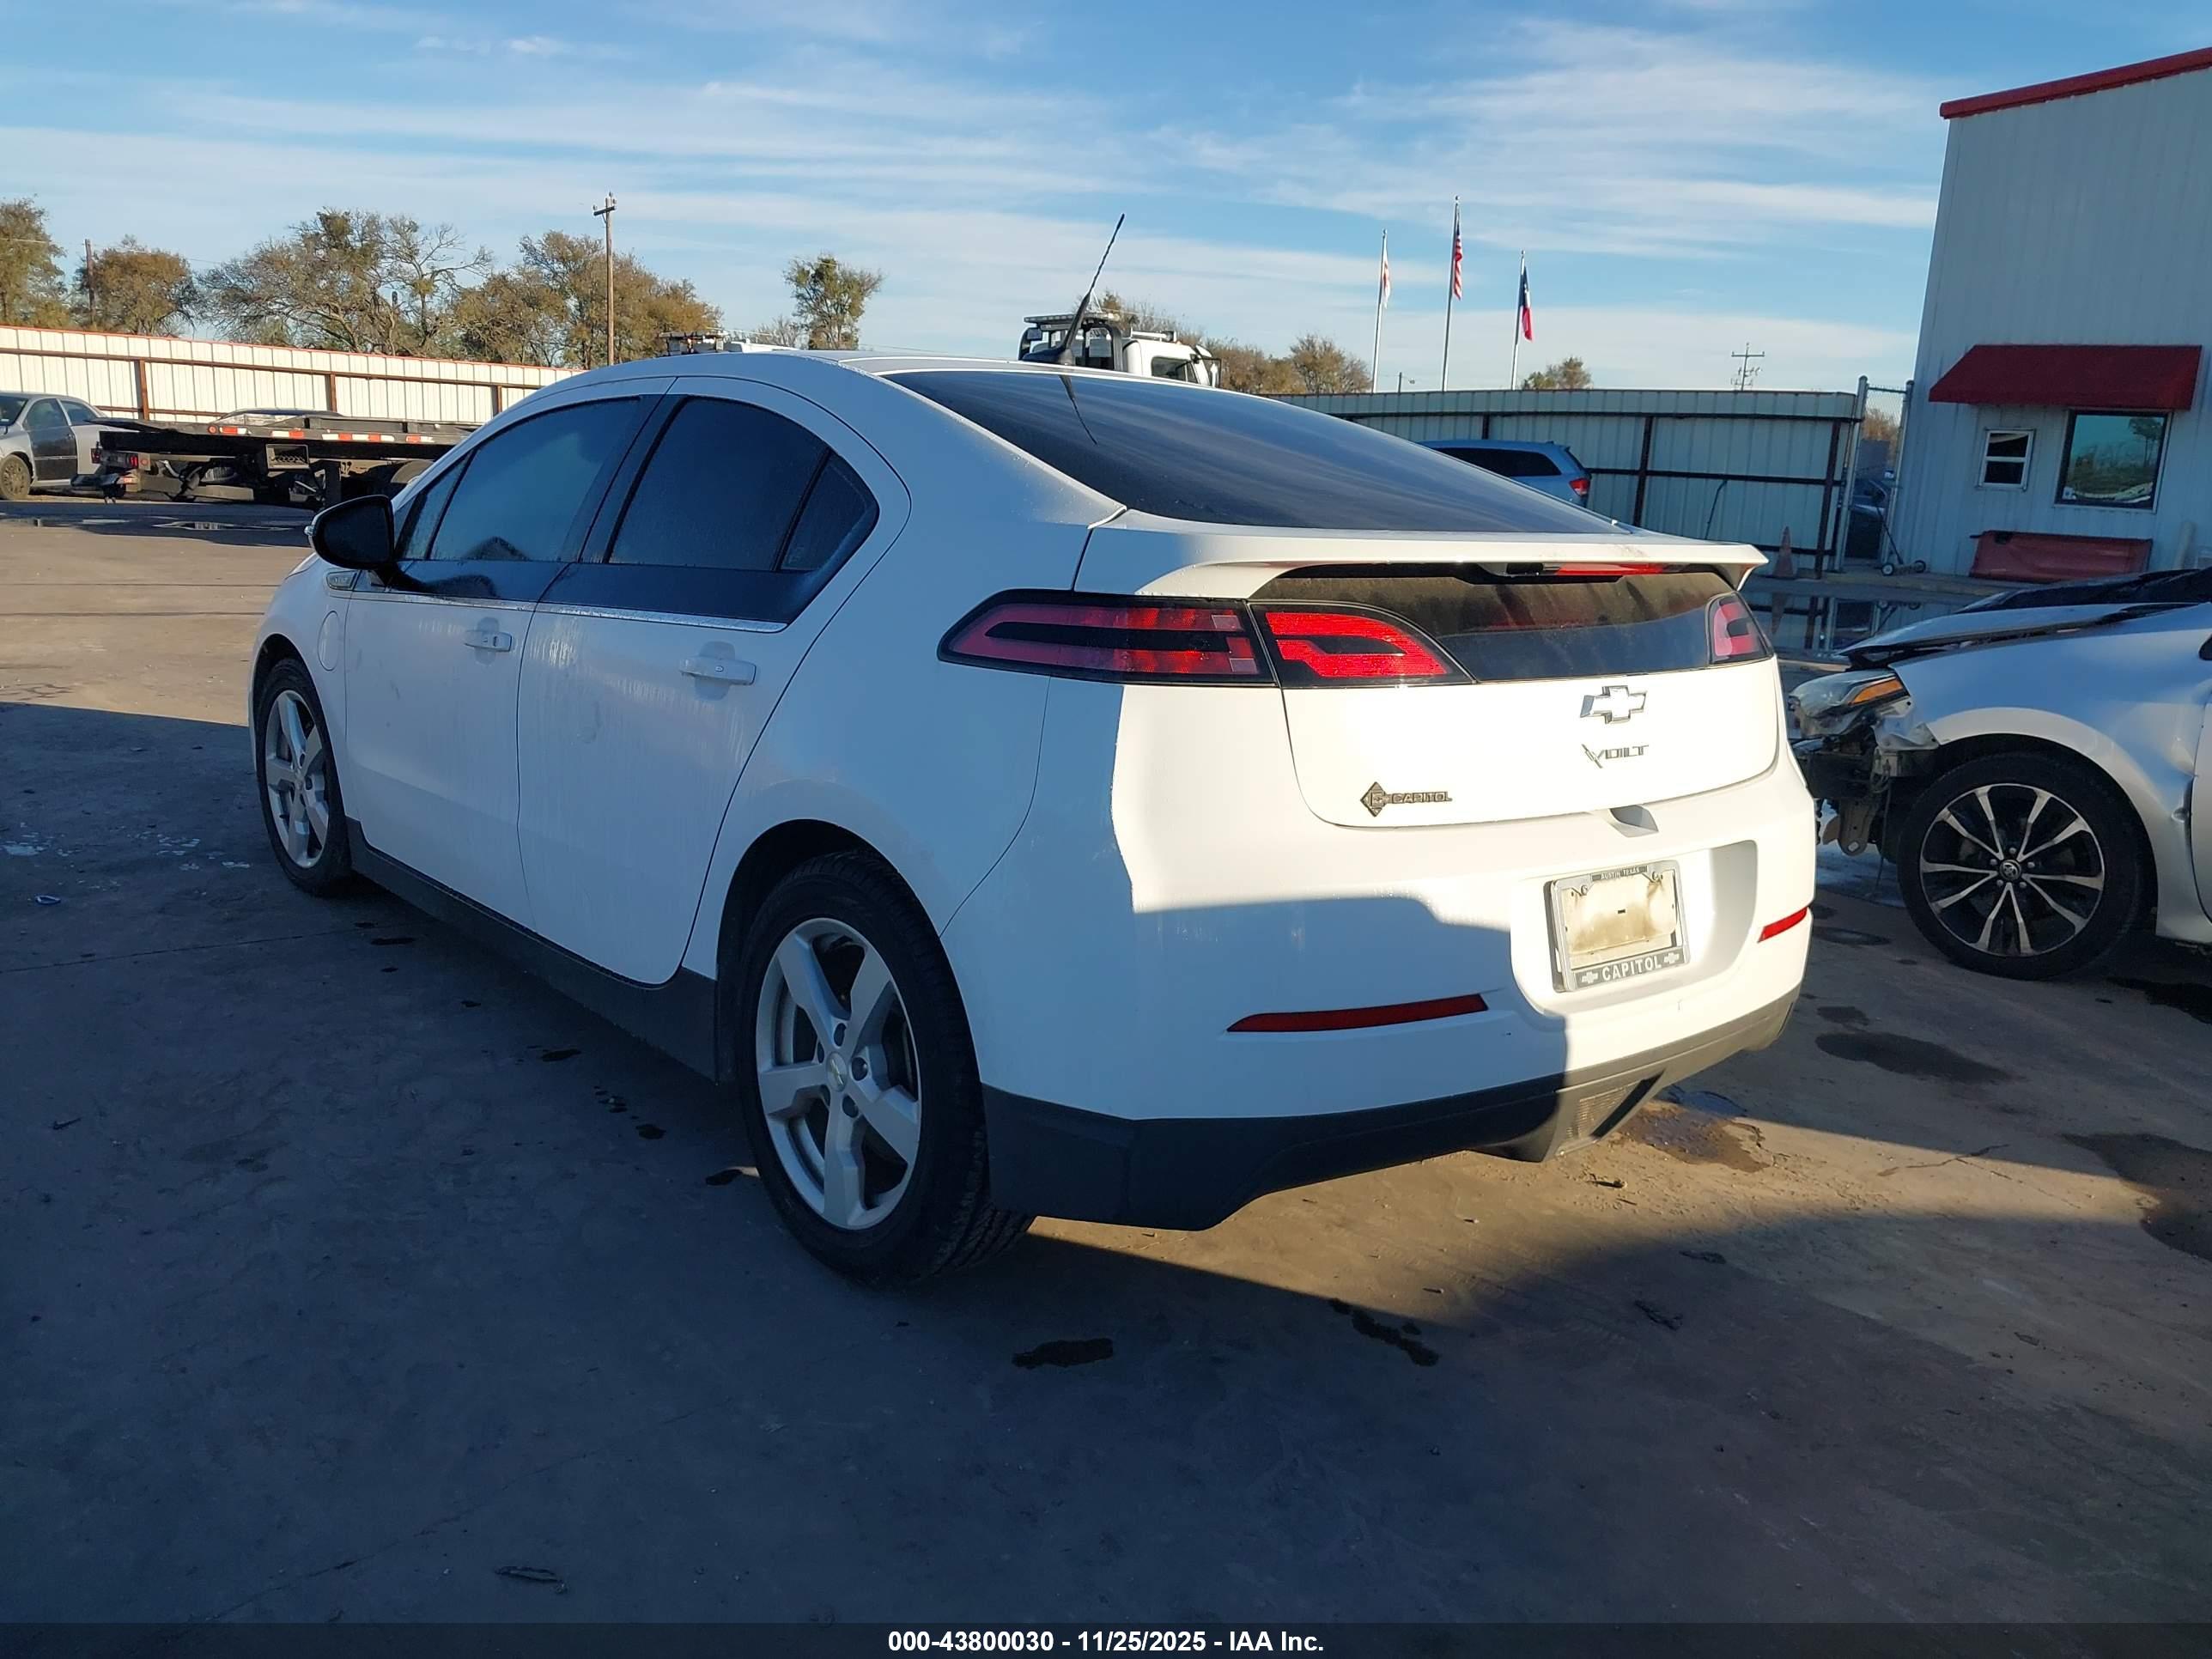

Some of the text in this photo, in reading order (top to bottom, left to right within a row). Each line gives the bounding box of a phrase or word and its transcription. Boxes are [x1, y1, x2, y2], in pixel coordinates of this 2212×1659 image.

[1581, 744, 1650, 769] VOLT
[1392, 791, 1453, 804] CAPITOL
[1601, 866, 1640, 880] AUSTIN TEXAS
[1601, 956, 1662, 981] CAPITOL
